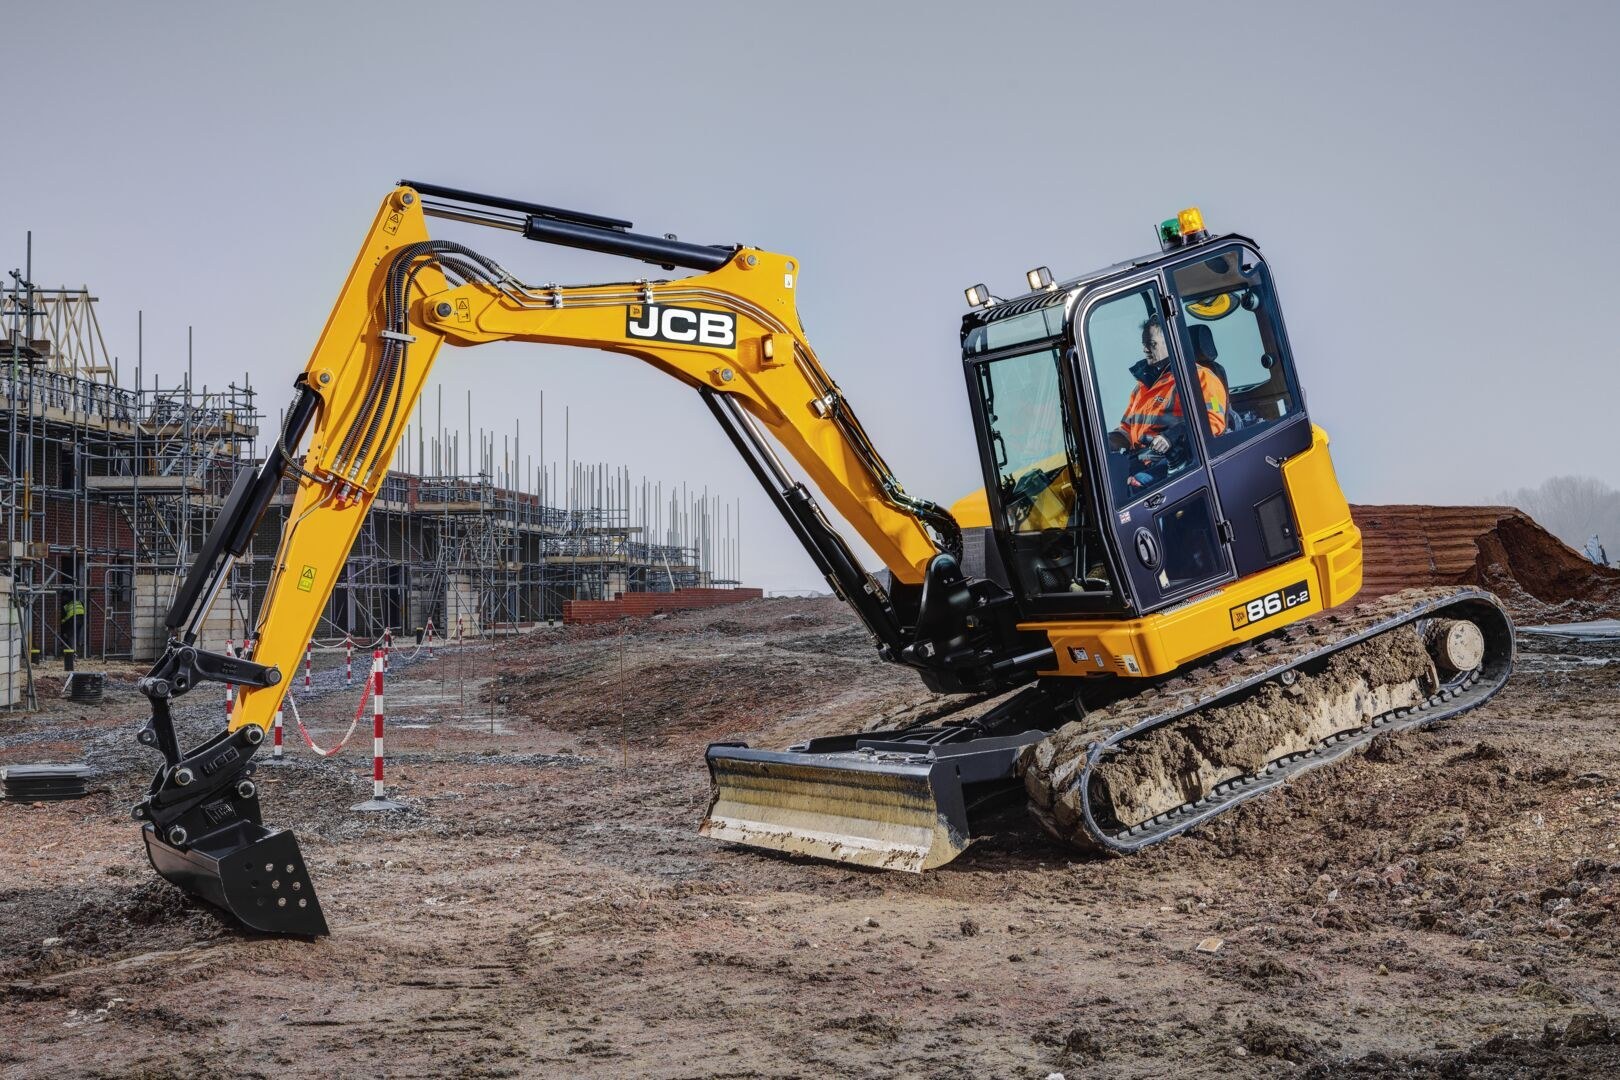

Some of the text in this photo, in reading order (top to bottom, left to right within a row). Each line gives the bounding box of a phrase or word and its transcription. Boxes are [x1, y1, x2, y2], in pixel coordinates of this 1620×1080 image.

[629, 306, 735, 346] JCB
[1246, 592, 1282, 622] 86
[1286, 590, 1309, 607] C-2
